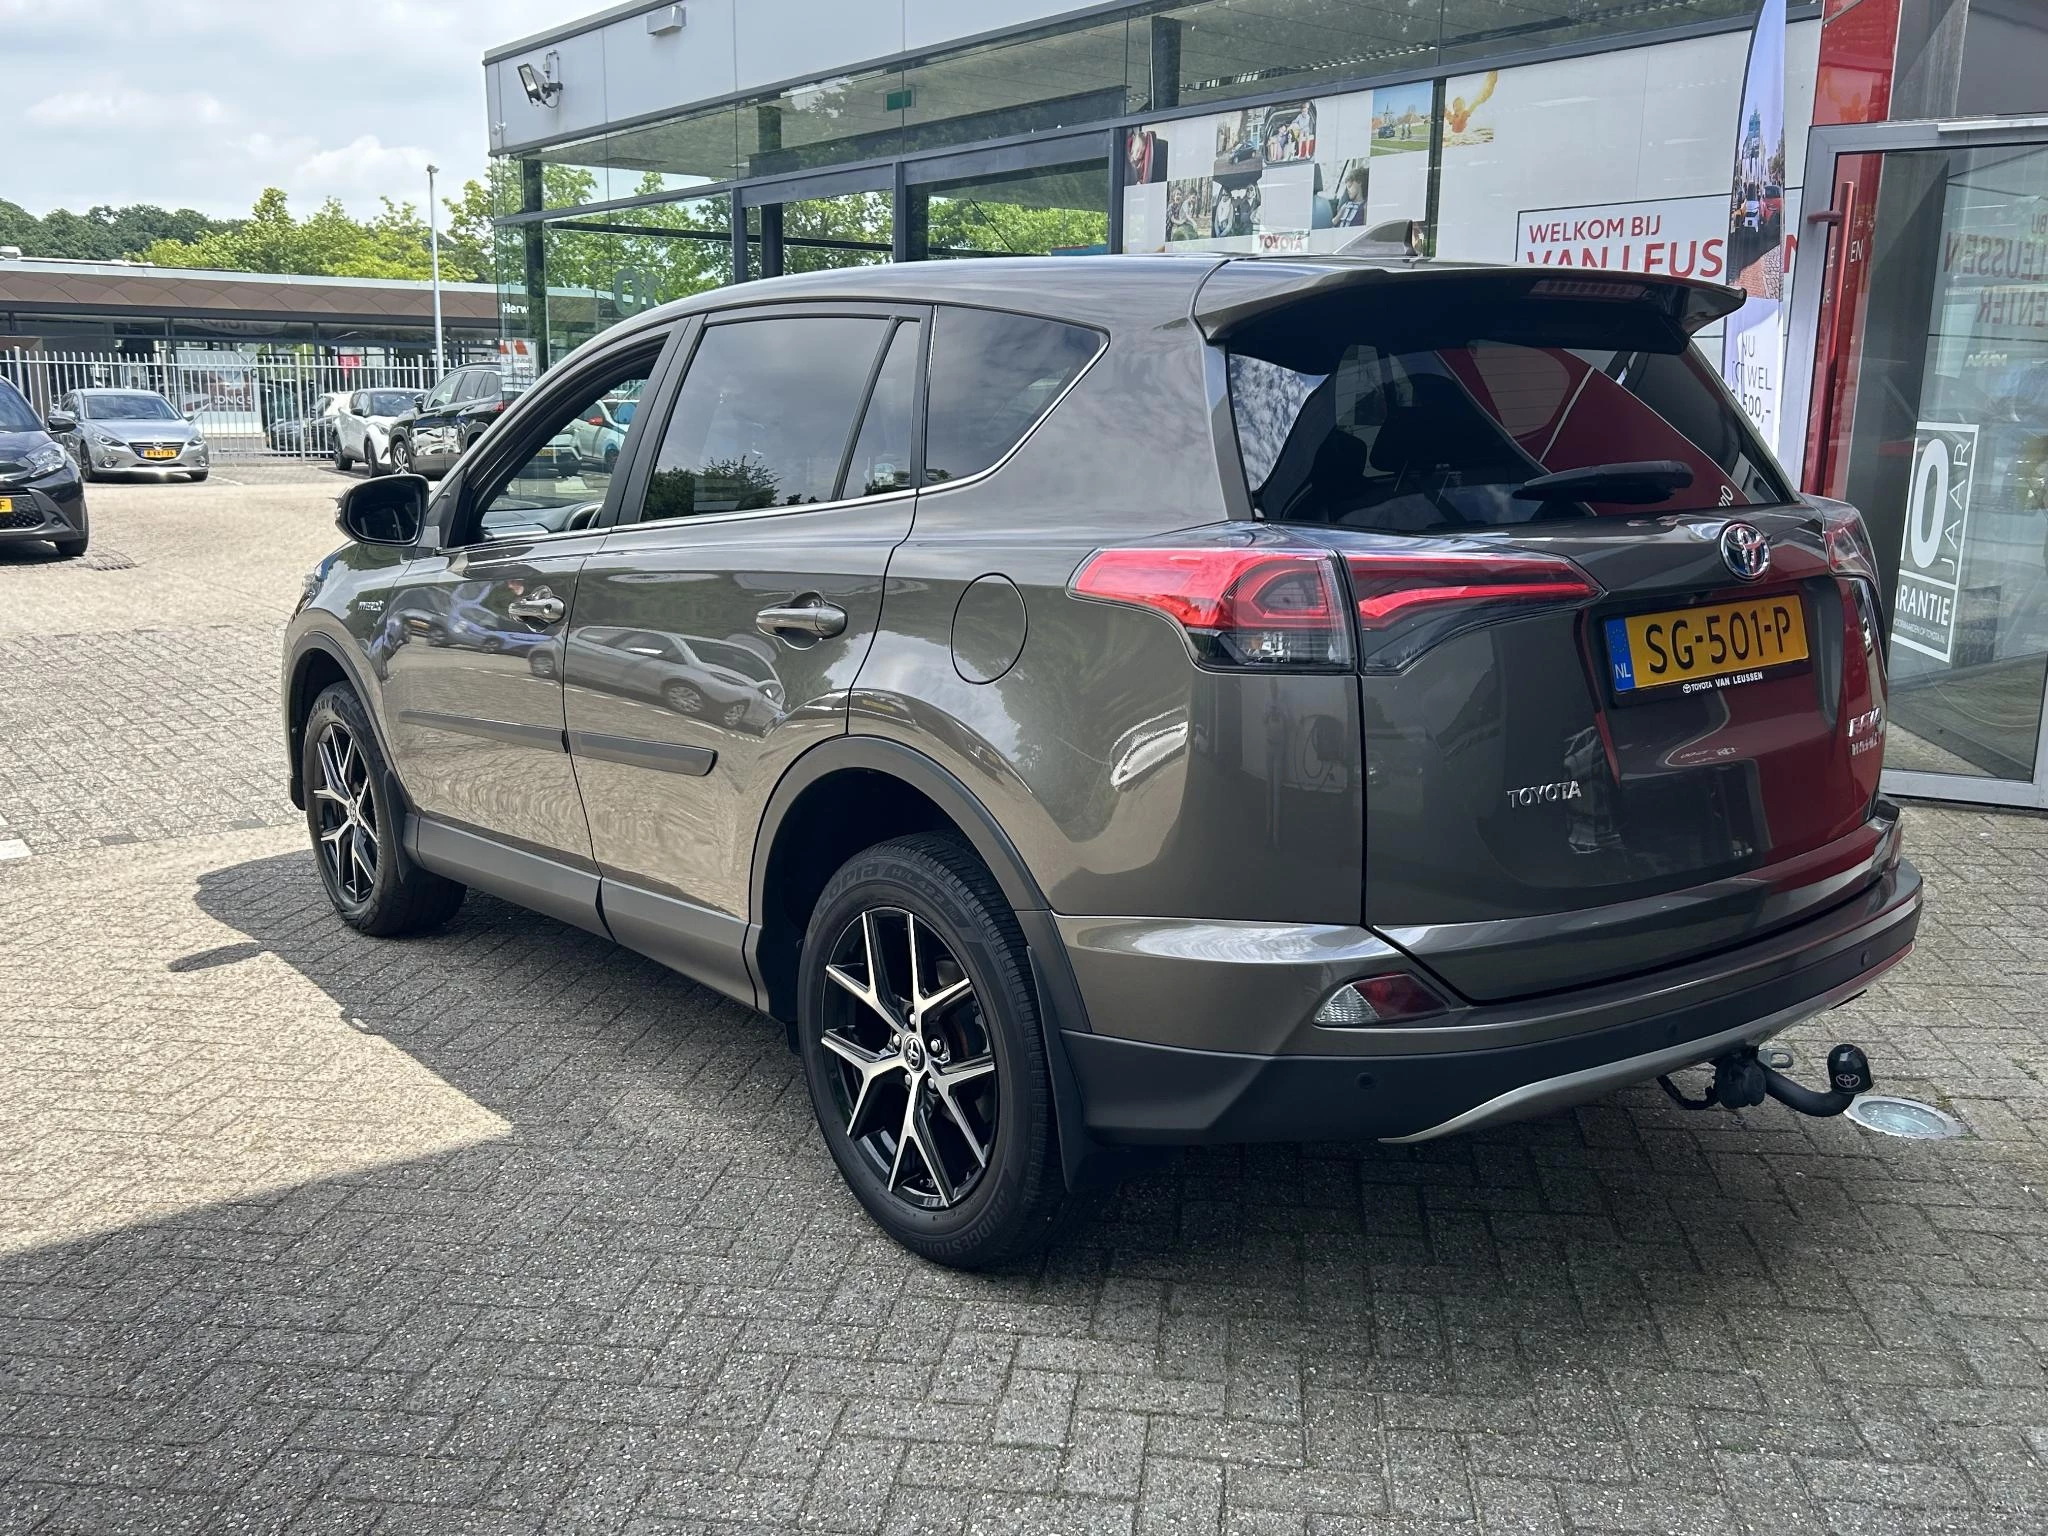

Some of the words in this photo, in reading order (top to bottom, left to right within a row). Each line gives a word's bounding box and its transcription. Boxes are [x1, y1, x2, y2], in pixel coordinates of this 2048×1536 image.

[1529, 217, 1624, 244] WELKOM
[1631, 214, 1661, 236] BIJ
[1259, 234, 1303, 250] TOYOTA
[1742, 335, 1756, 357] NU
[1747, 366, 1772, 391] WEL
[1941, 441, 1971, 576] JAAR
[1645, 606, 1791, 674] SG-501-P
[1614, 662, 1631, 678] NL
[1691, 681, 1713, 691] TOYOTA
[1715, 677, 1731, 687] VAN
[1732, 671, 1763, 685] LEUSSEN
[1506, 780, 1582, 809] TOYOTA
